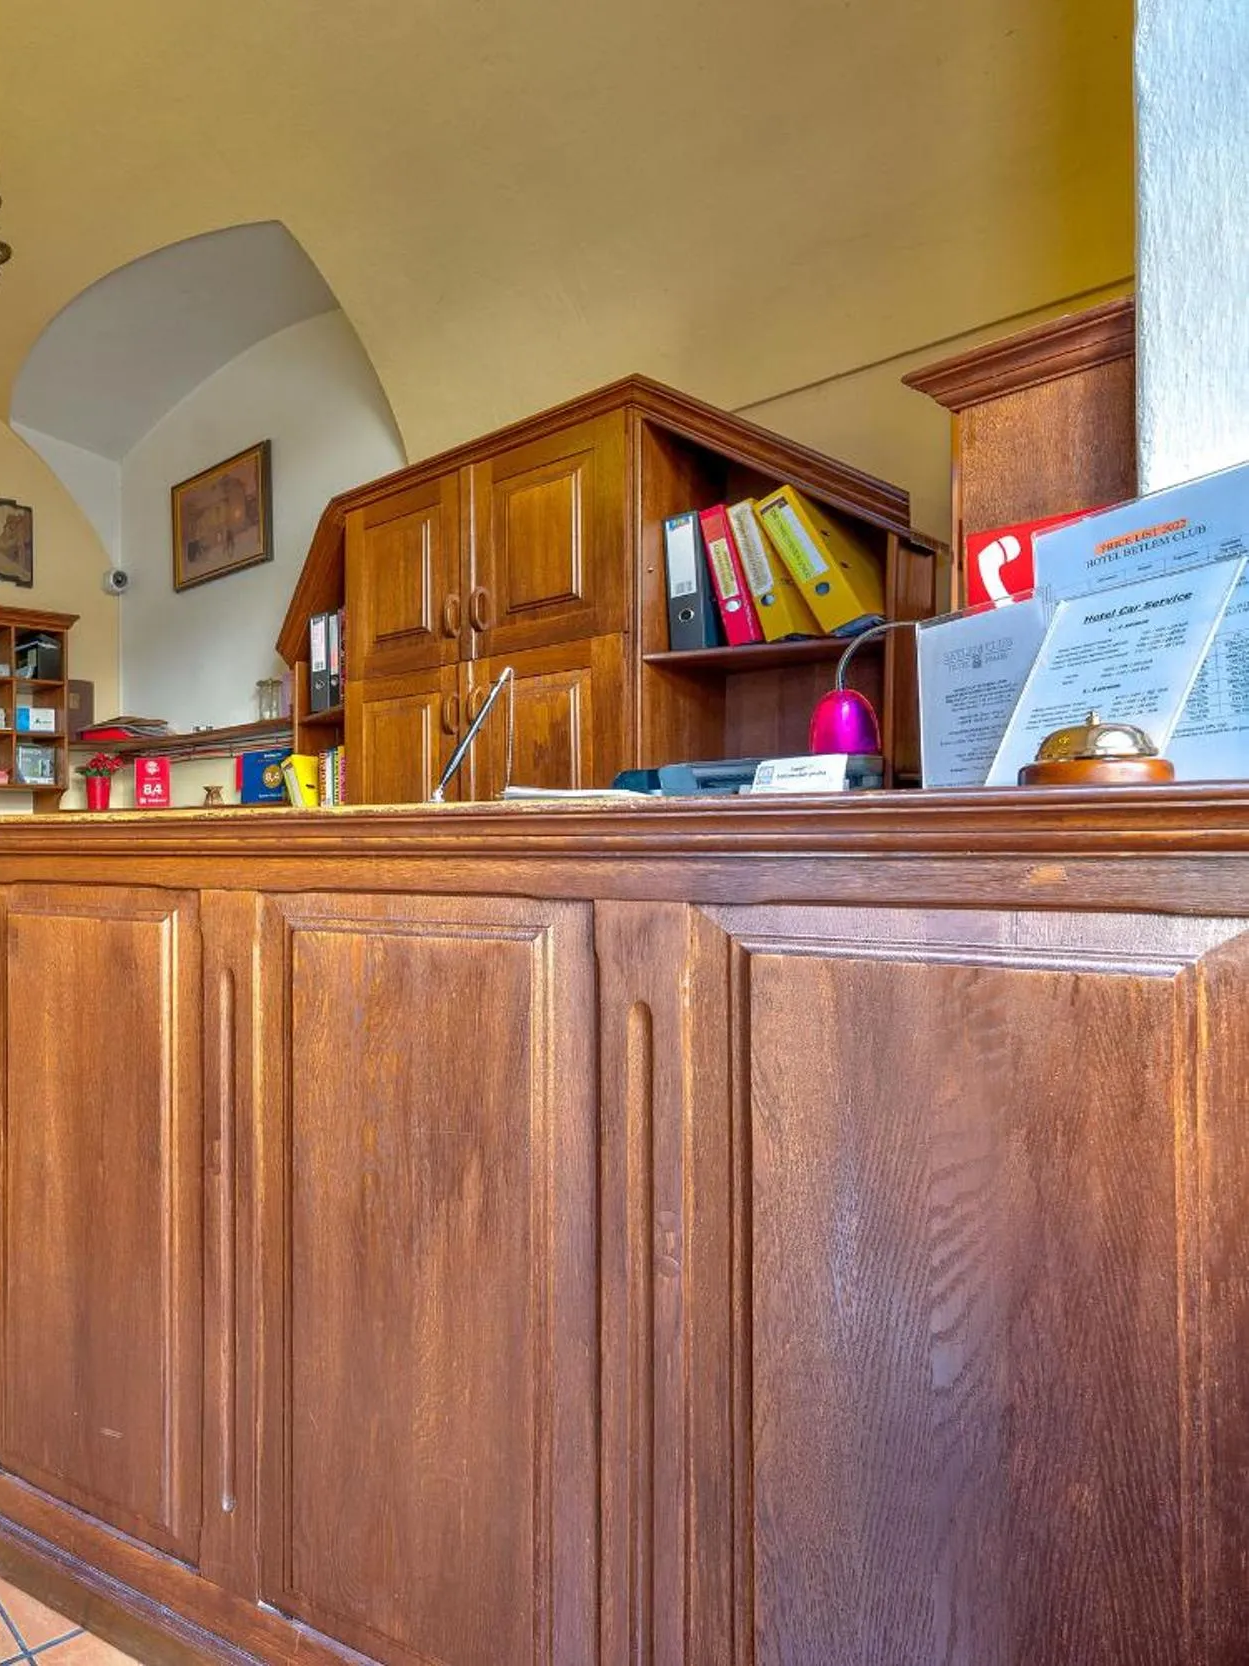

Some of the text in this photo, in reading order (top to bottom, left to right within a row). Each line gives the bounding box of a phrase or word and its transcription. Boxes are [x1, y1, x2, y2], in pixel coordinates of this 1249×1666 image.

[1086, 551, 1121, 569] HOTEL
[1123, 537, 1171, 558] BETLEM
[1172, 524, 1207, 543] CLUB
[1134, 527, 1158, 543] LIST
[1083, 592, 1193, 625] Hotel Car Service
